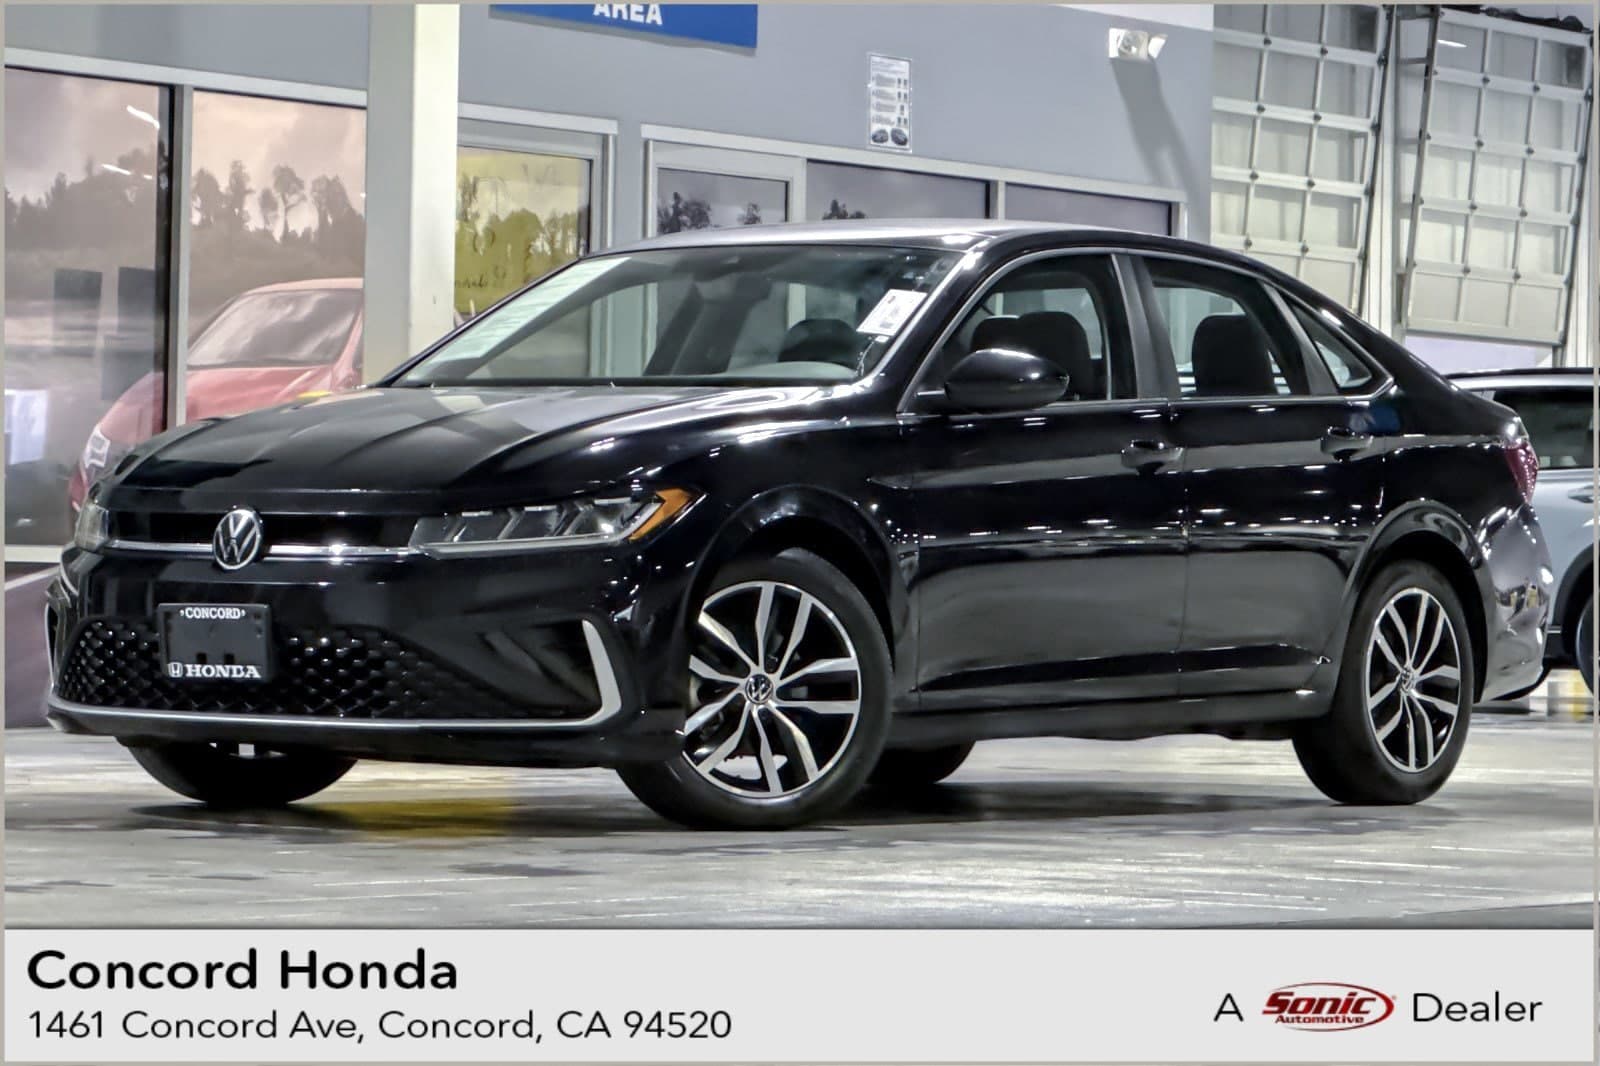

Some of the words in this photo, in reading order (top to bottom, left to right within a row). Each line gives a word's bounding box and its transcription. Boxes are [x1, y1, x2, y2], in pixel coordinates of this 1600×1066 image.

[593, 4, 663, 25] AREA
[185, 607, 241, 619] CONCORD
[185, 664, 262, 679] HONDA
